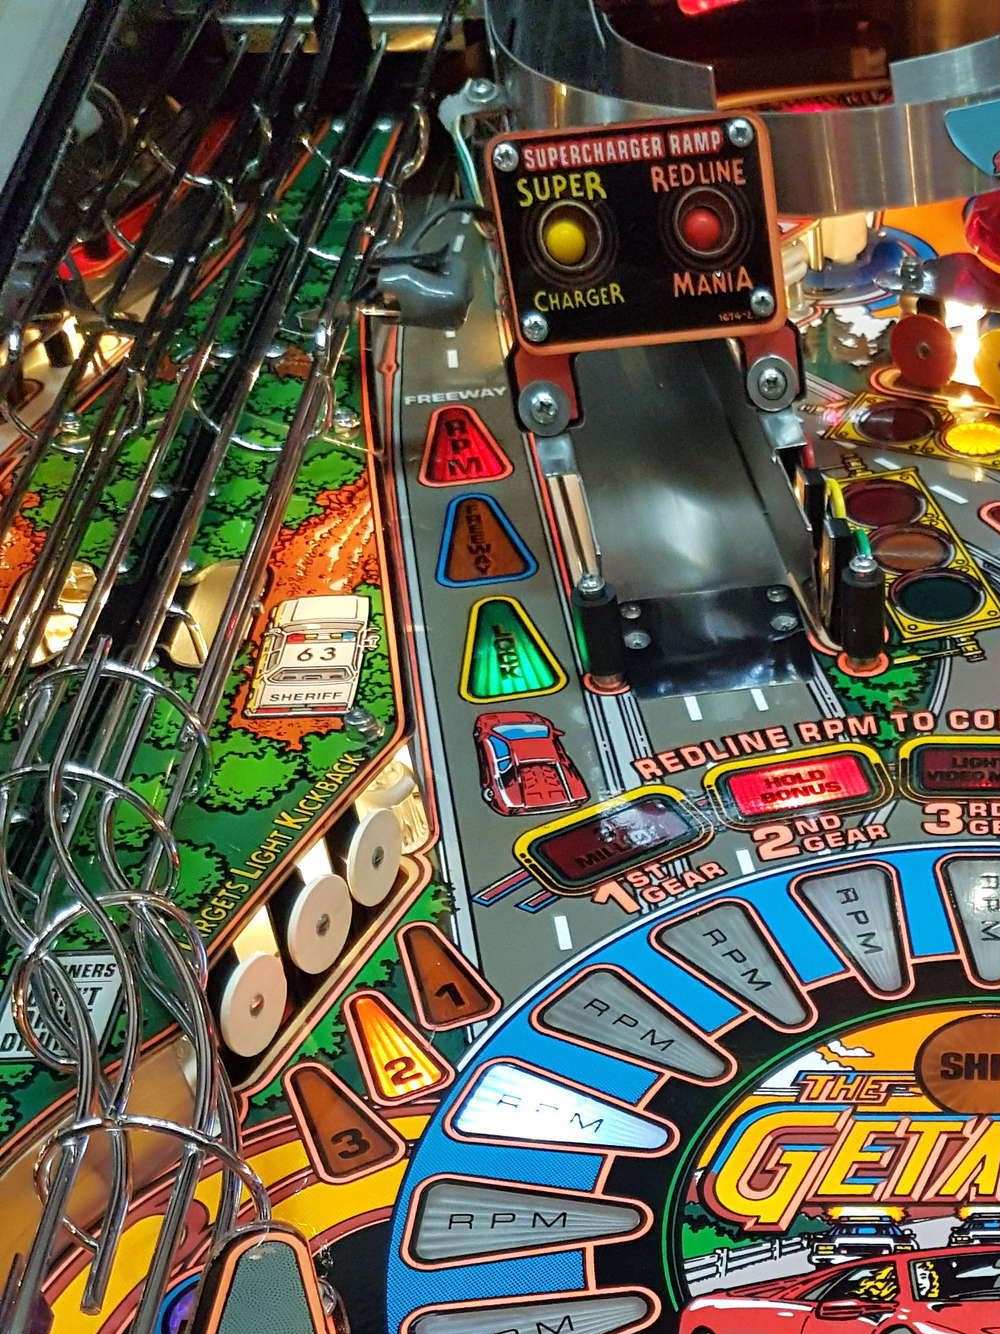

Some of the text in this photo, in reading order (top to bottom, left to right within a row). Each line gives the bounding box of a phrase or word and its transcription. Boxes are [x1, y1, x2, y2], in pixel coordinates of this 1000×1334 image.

[524, 130, 721, 169] SUPERCHARGER RAMP
[516, 172, 607, 206] SUPER
[673, 266, 754, 297] MANIA
[534, 283, 625, 312] CHARGER
[405, 387, 506, 405] FREEWAY
[445, 420, 480, 475] RPM
[270, 691, 344, 702] SHERIFF
[633, 725, 791, 780] REDLINE
[798, 713, 879, 745] RPM
[890, 711, 934, 732] TO
[759, 781, 842, 803] BONUS
[764, 769, 826, 789] HOLD
[230, 753, 366, 880] LIGHT KICKBACK
[804, 824, 889, 853] GEAR
[641, 862, 726, 903] GEAR
[836, 887, 884, 954] RPM
[702, 928, 772, 993] RPM
[435, 983, 466, 1007] 1
[583, 998, 677, 1053] RPM
[384, 1056, 423, 1087] 2
[801, 1075, 889, 1104] THE
[337, 1128, 369, 1159] 3
[448, 1211, 567, 1230] RPM
